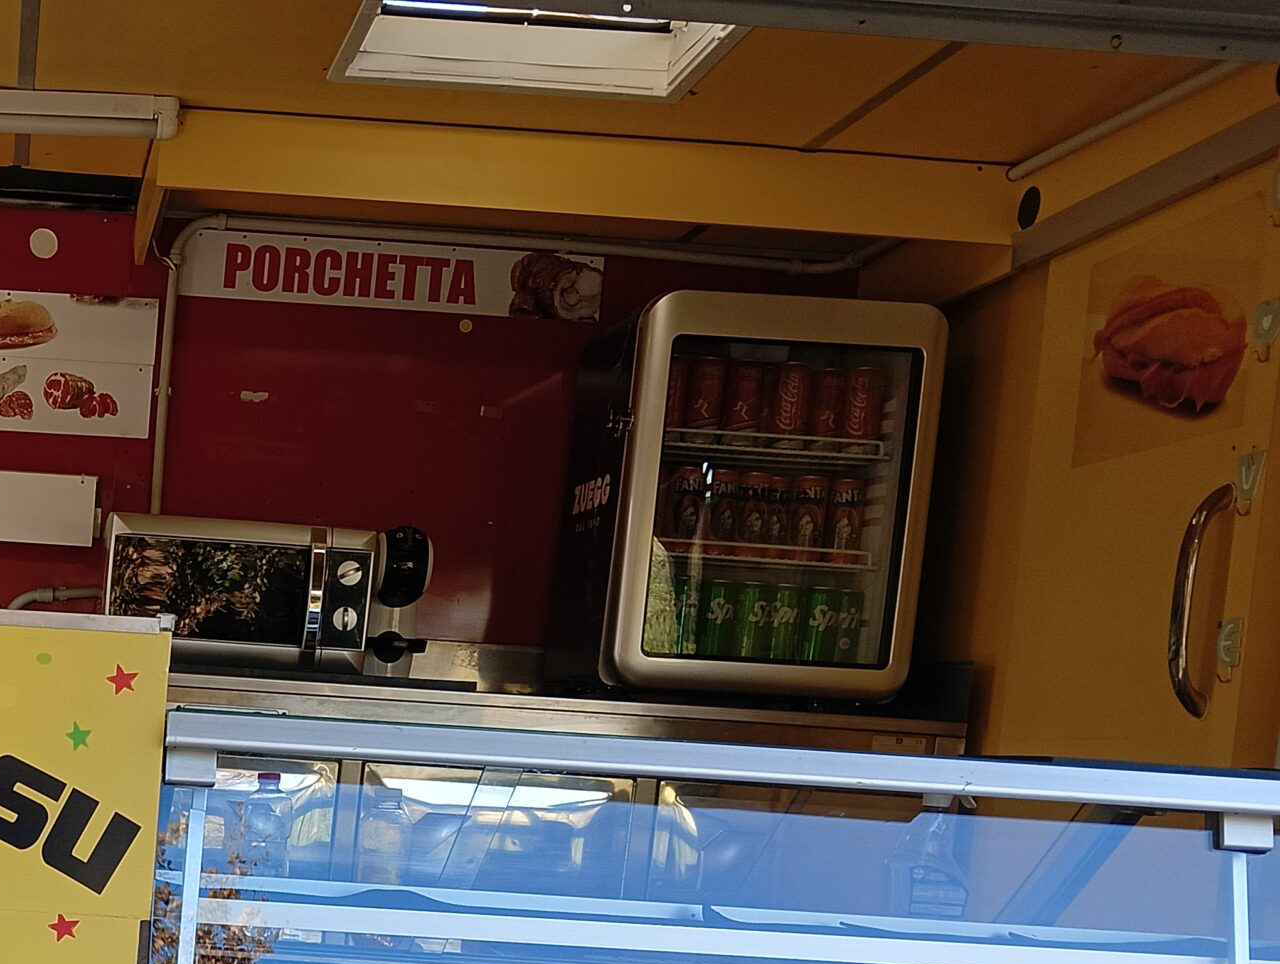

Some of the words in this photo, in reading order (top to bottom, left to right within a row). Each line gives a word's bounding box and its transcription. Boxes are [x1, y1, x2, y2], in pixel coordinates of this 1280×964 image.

[222, 242, 478, 306] PORCHETTA
[571, 473, 611, 515] ZUEGG
[675, 478, 705, 494] FANT
[712, 479, 739, 495] FAN
